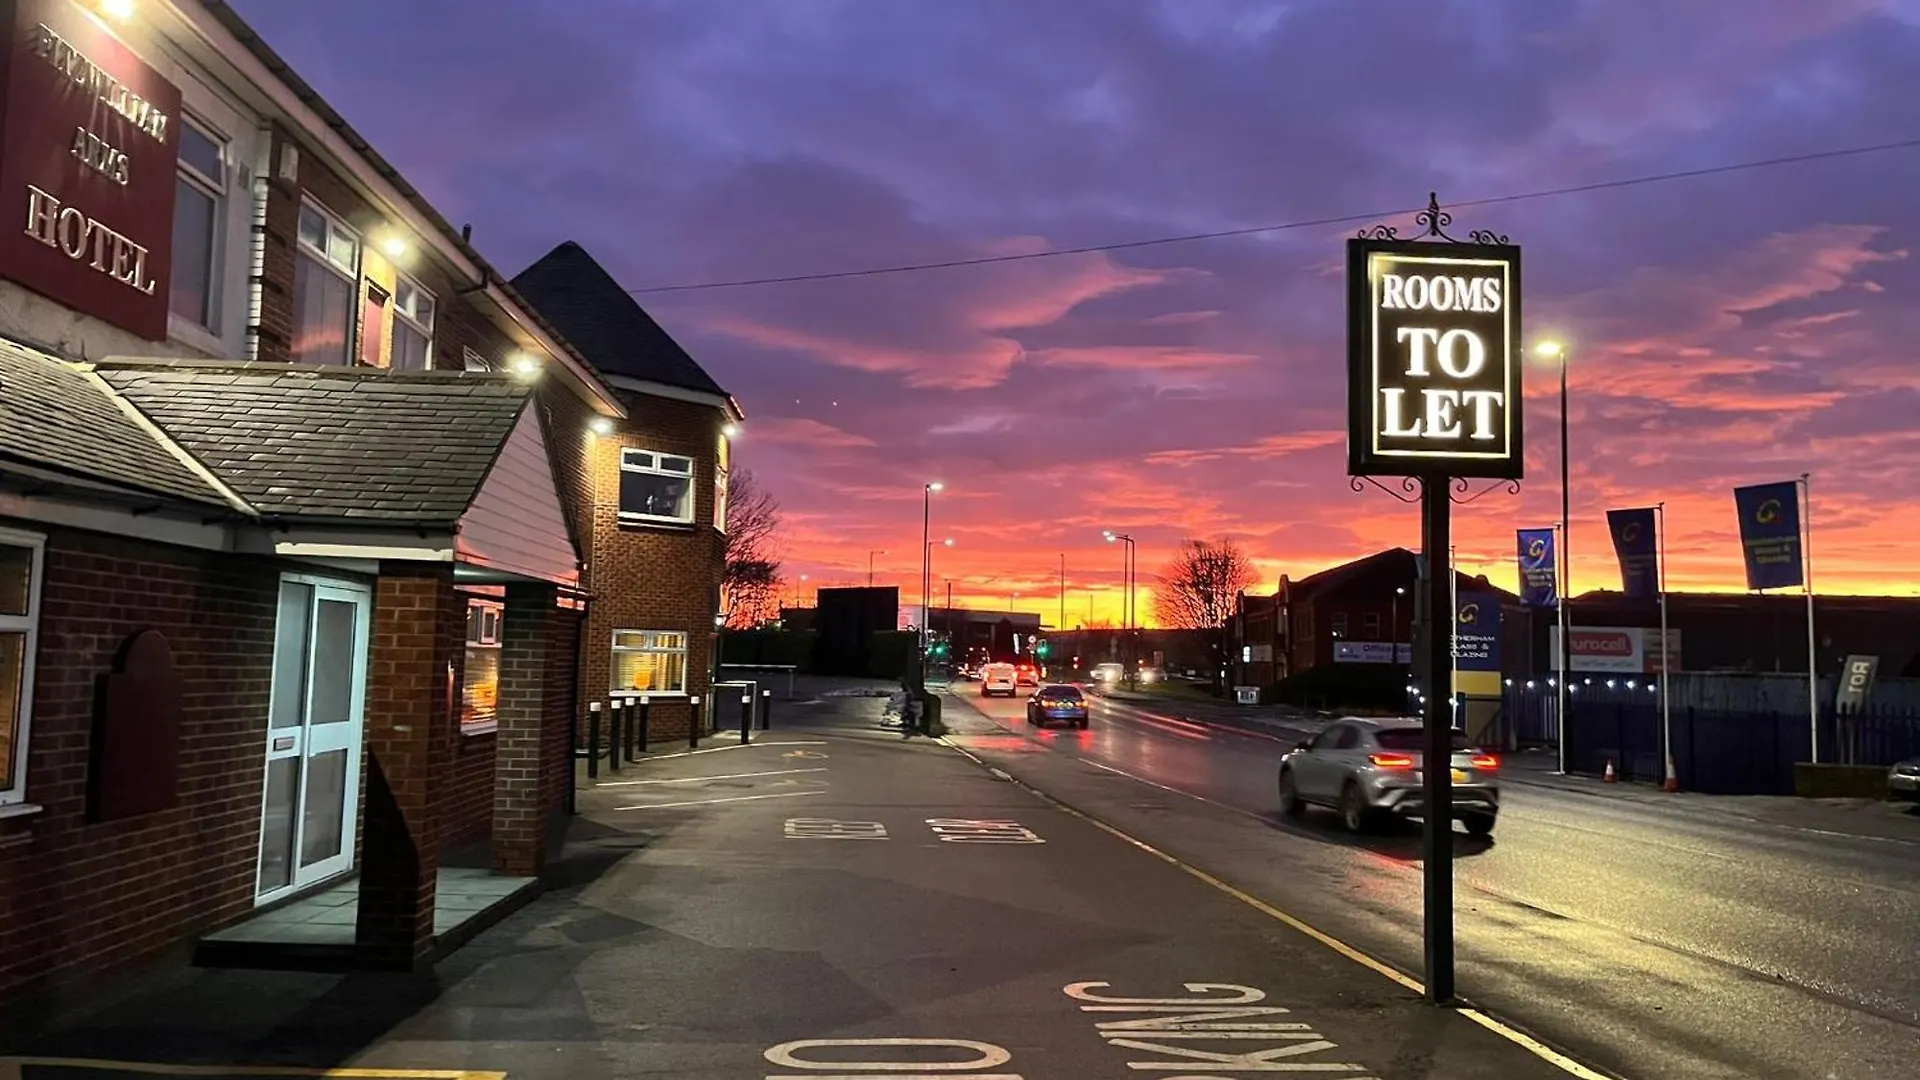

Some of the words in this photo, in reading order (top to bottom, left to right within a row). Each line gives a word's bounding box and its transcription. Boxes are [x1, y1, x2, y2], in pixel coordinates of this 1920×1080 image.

[70, 126, 130, 186] ARMS
[24, 184, 156, 296] HOTEL
[1381, 273, 1501, 313] ROOMS
[1397, 327, 1484, 378] TO
[1380, 388, 1503, 439] LET
[1567, 638, 1628, 652] urocell
[784, 817, 890, 840] KEEP
[925, 818, 1046, 844] CLEAR
